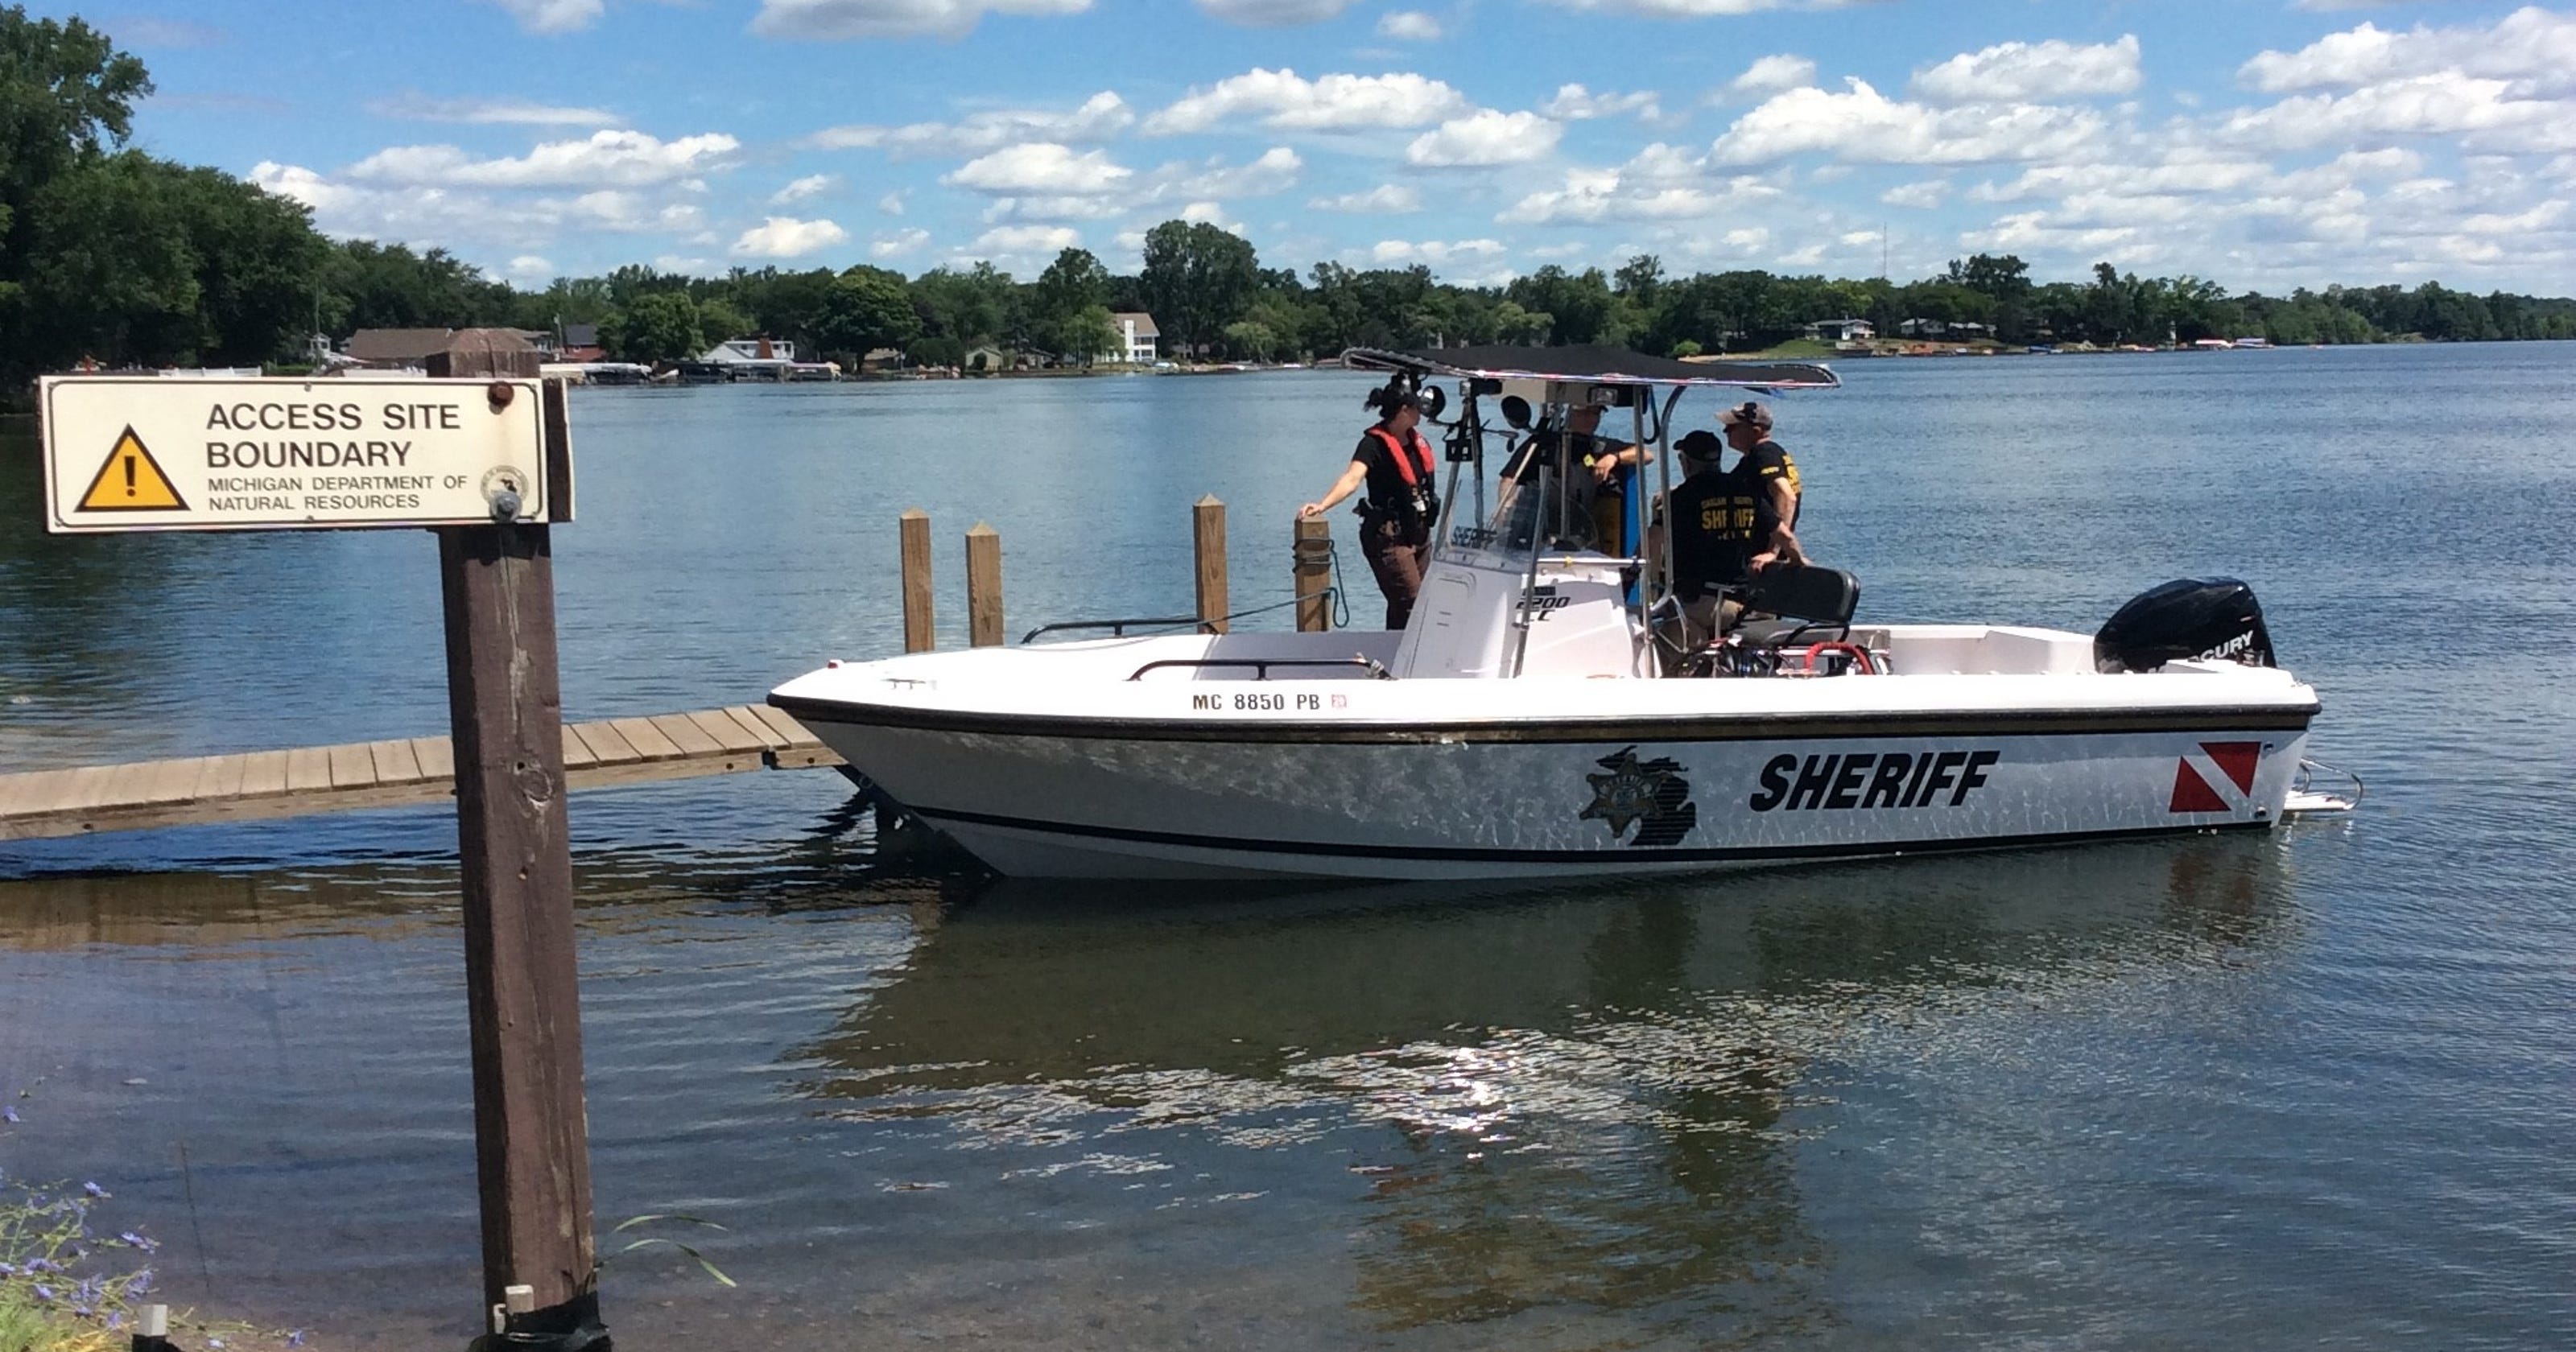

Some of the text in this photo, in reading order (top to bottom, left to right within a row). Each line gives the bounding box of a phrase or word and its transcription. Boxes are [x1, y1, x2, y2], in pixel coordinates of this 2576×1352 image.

[206, 402, 460, 430] ACCESS SITE
[206, 441, 412, 468] BOUNDARY
[208, 477, 303, 492] MICHIGAN
[312, 476, 434, 490] DEPARTMENT
[444, 475, 467, 489] OF
[209, 494, 420, 510] NATURAL RESOURCES
[2187, 630, 2254, 662] CURY
[1193, 694, 1222, 710] MC
[1234, 694, 1285, 710] 8850
[1297, 694, 1321, 710] PB
[1749, 750, 2000, 812] SHERIFF
